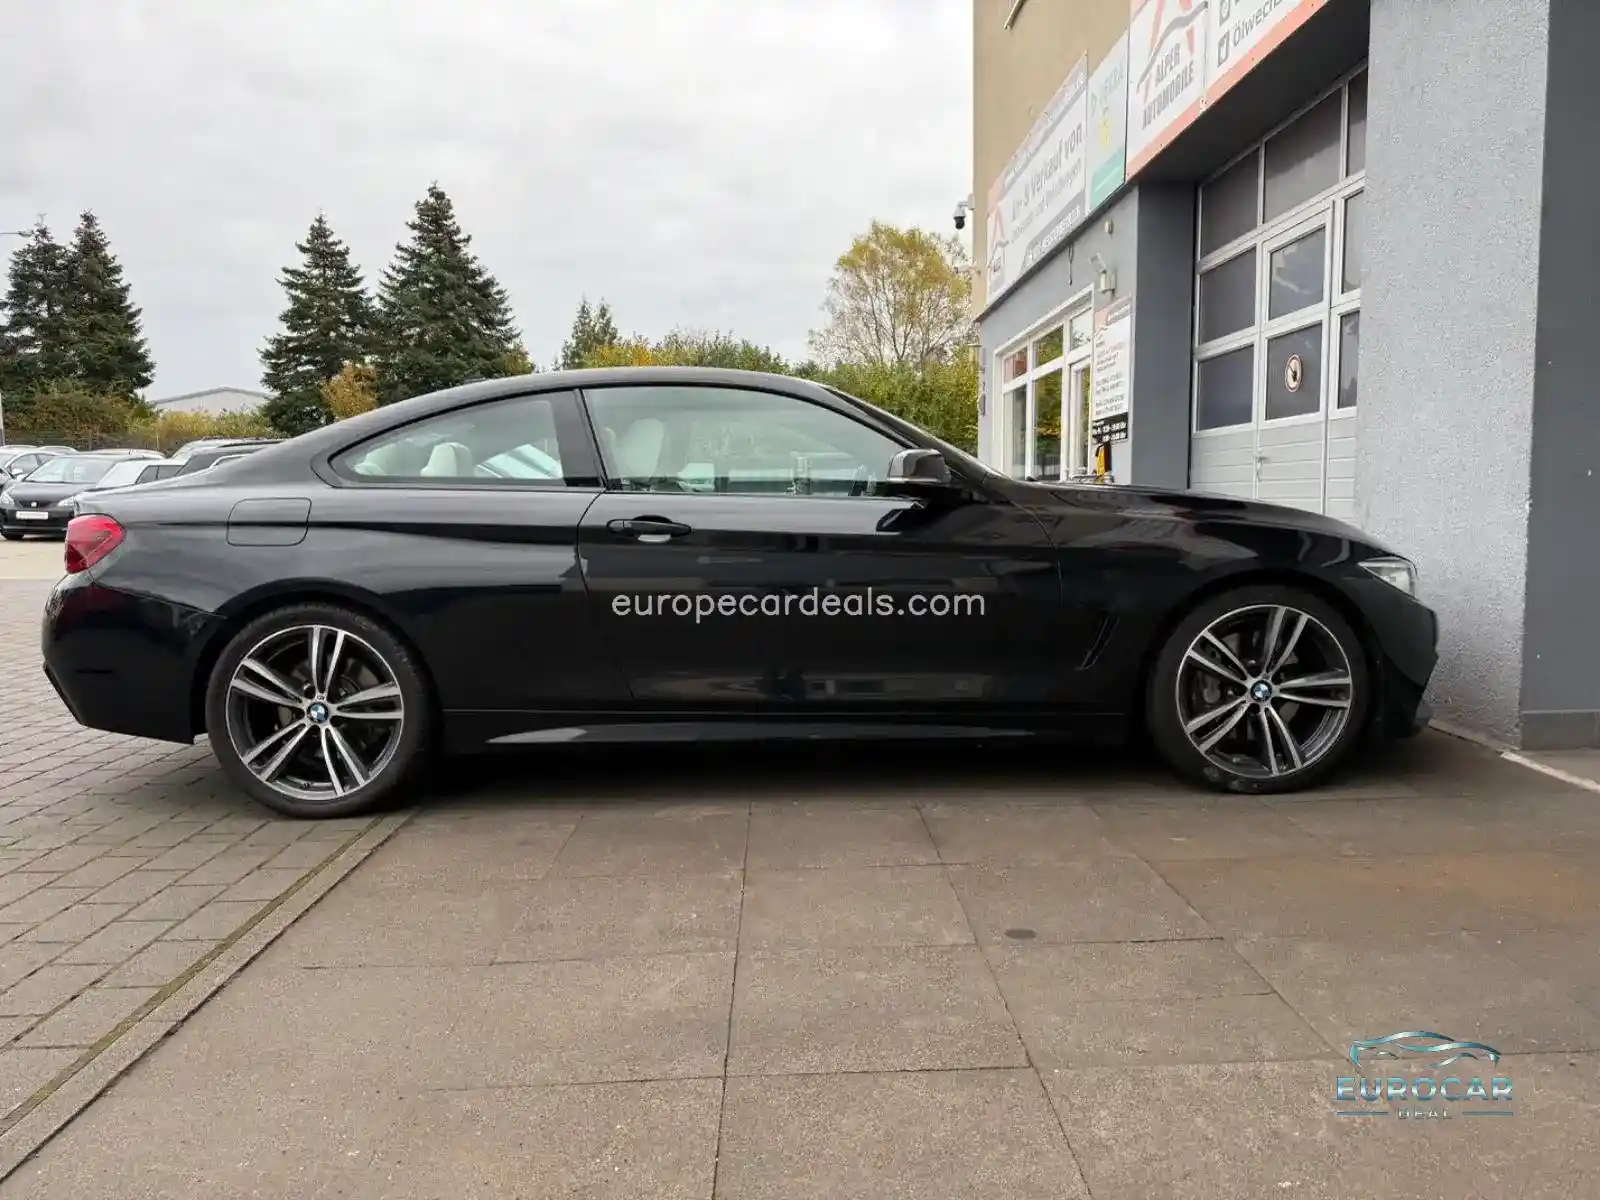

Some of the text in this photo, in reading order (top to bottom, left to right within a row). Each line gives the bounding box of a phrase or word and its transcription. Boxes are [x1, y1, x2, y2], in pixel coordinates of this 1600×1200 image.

[1142, 59, 1194, 131] AUTOMOBILE
[1154, 42, 1180, 88] ALPER
[1031, 136, 1063, 198] Verkauf
[1064, 122, 1083, 160] von
